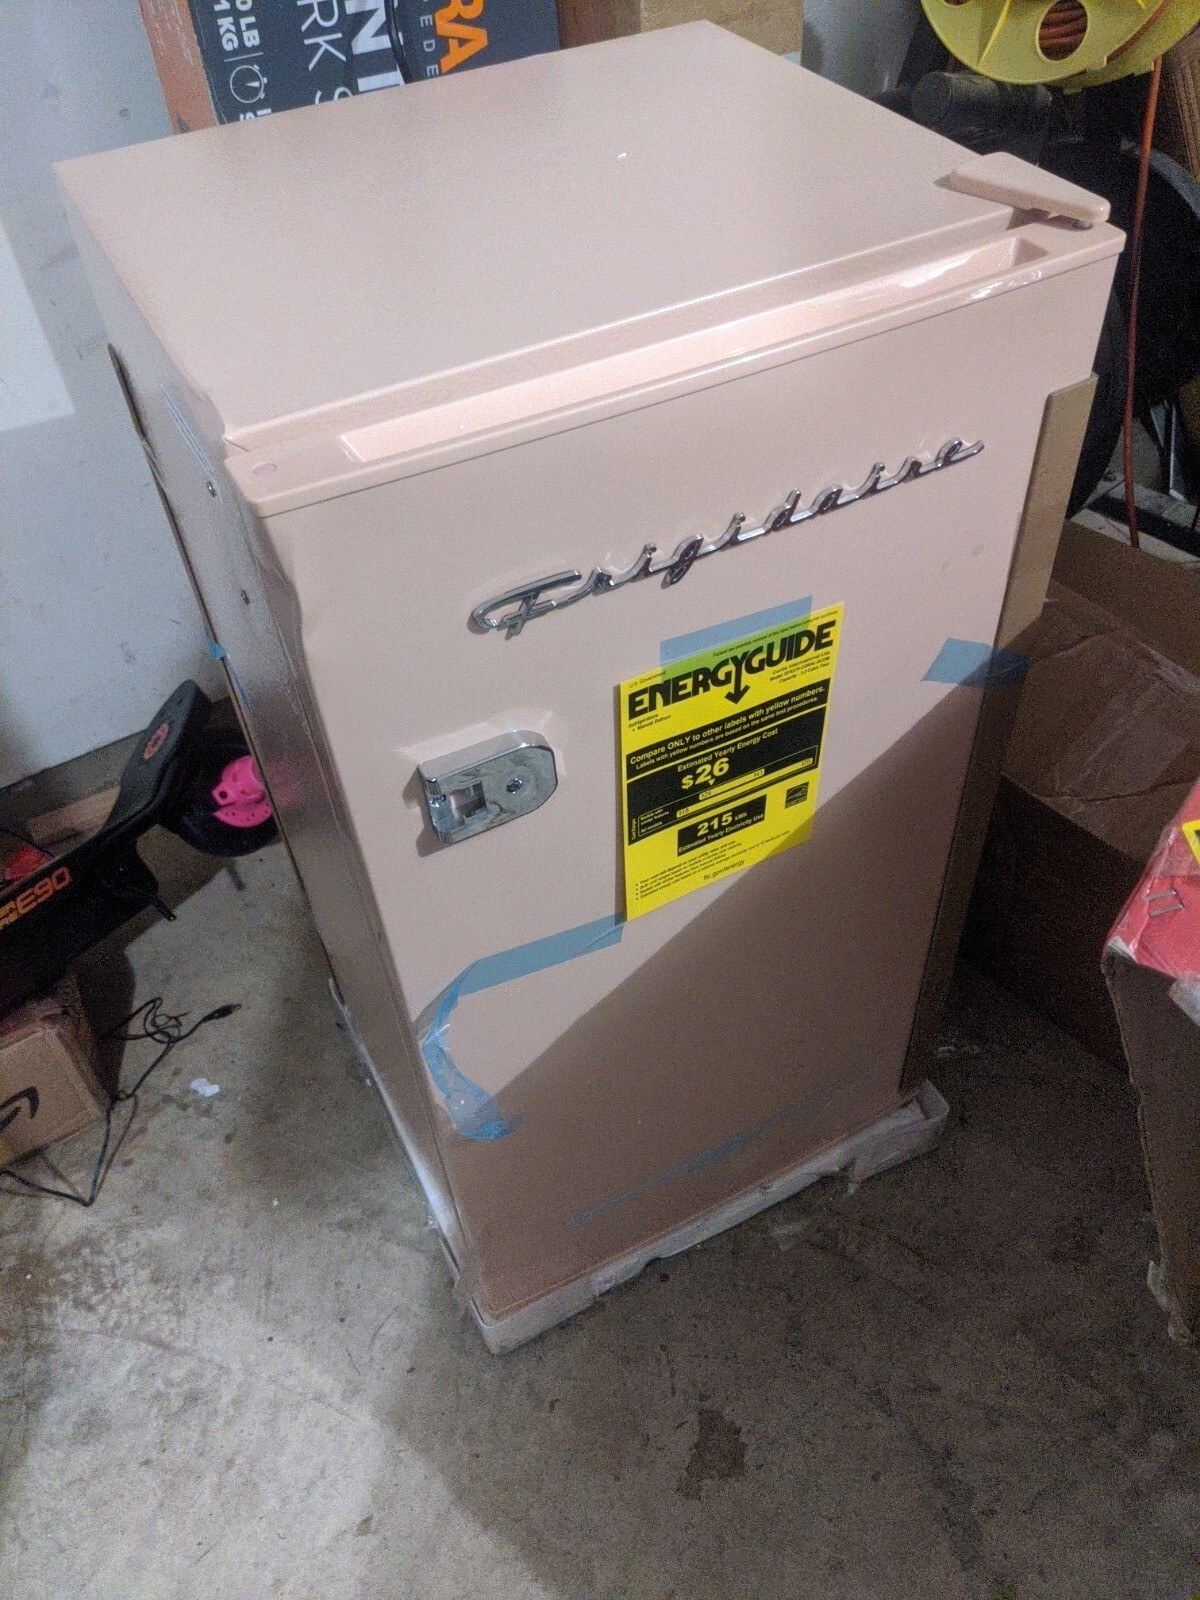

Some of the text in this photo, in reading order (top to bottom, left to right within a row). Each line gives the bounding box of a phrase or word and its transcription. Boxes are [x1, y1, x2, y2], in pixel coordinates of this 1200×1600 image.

[217, 16, 239, 51] KG
[239, 16, 260, 47] LB
[472, 438, 985, 636] Frigidaire
[628, 619, 836, 720] ENERGYGUIDE
[639, 669, 666, 684] Government
[630, 683, 825, 765] Compare ONLY to other labels with yellow numbers.
[635, 757, 655, 770] Labels
[656, 752, 668, 762] with
[669, 745, 688, 758] yellow
[689, 735, 713, 750] numbers
[714, 732, 723, 740] are
[724, 725, 741, 736] based
[750, 718, 759, 726] the
[760, 713, 774, 722] same
[775, 707, 786, 716] test
[786, 695, 819, 712] procedures.
[677, 726, 778, 772] Estimated Yearly Energy Cost
[680, 755, 729, 791] $26
[678, 836, 706, 853] Estimated
[706, 829, 724, 841] Yearly
[725, 817, 752, 833] Electricity
[752, 812, 763, 821] Use
[697, 811, 747, 836] 215 kWh
[703, 858, 744, 881] ftc.gov/energy
